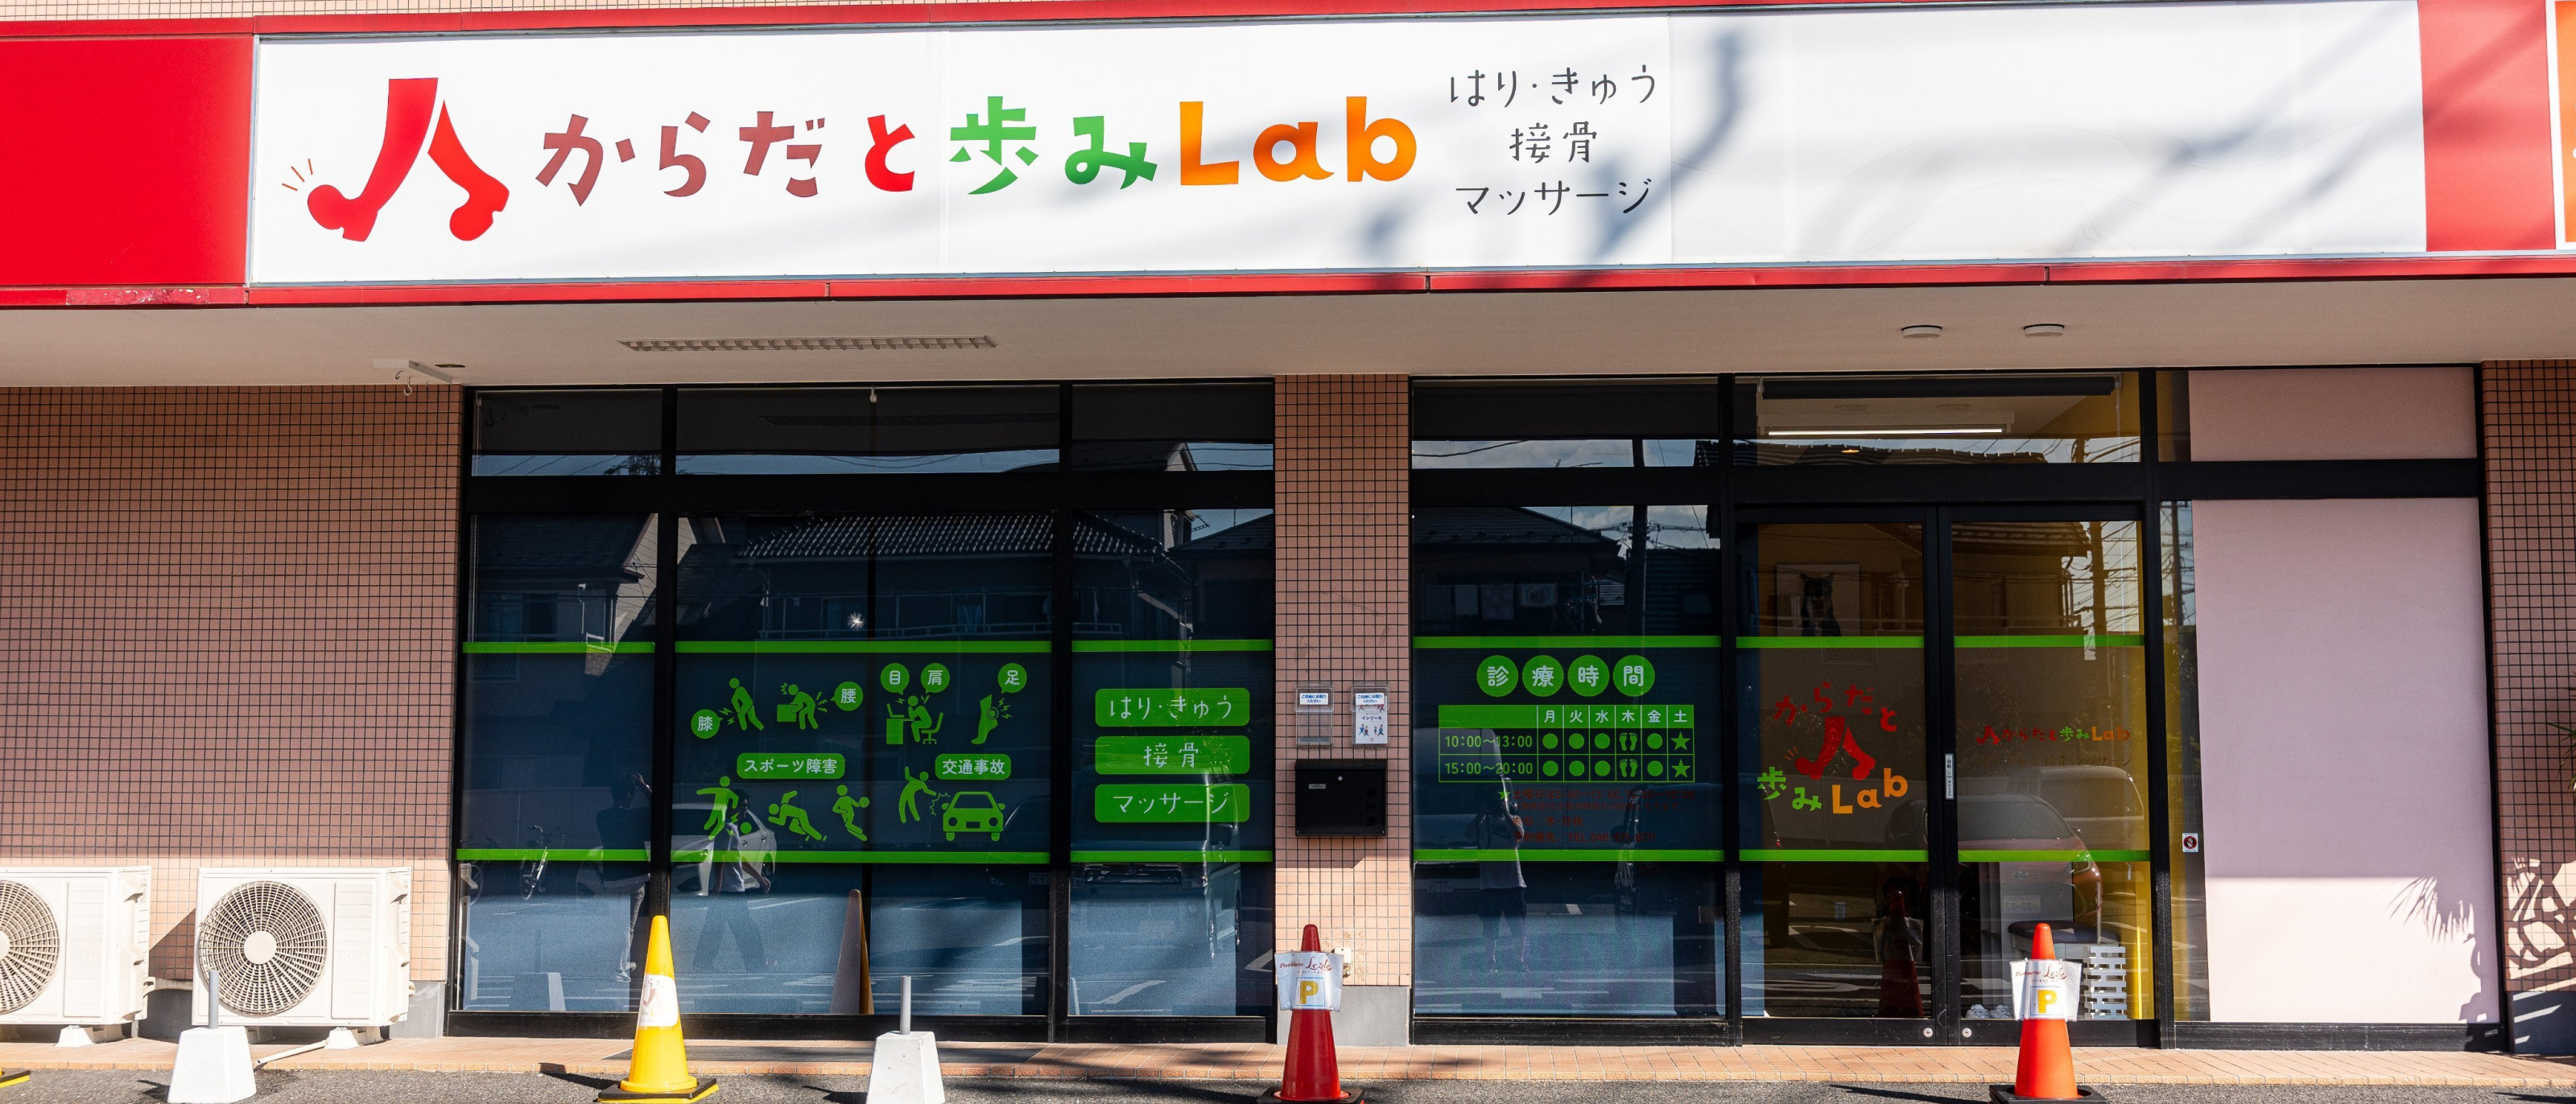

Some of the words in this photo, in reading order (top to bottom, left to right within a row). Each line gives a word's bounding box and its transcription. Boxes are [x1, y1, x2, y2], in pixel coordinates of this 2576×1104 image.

[1450, 64, 1657, 109] はり・きゅう
[1509, 121, 1598, 164] 接骨
[1455, 177, 1653, 216] マッサージ
[890, 670, 902, 686] 目
[928, 669, 944, 686] 肩
[1005, 670, 1021, 686] 足
[1487, 665, 1644, 688] 診療時間
[840, 688, 857, 705] 腰
[1110, 694, 1232, 720] はり・きゅう
[1773, 682, 1897, 732] からだと
[697, 715, 714, 732] 膝
[1543, 710, 1556, 724] 月
[1569, 710, 1583, 724] 火
[1595, 710, 1609, 724] 水
[1621, 710, 1636, 724] 木
[1646, 710, 1662, 724] 金
[1674, 710, 1688, 724] 土
[1143, 742, 1199, 768] 接骨
[745, 758, 838, 777] スポーツ障害
[943, 759, 1006, 777] 交通事故
[1757, 766, 1909, 814] 歩みLab
[1113, 792, 1229, 814] マッサージ
[1299, 980, 1319, 1005] P
[2037, 989, 2058, 1014] P
